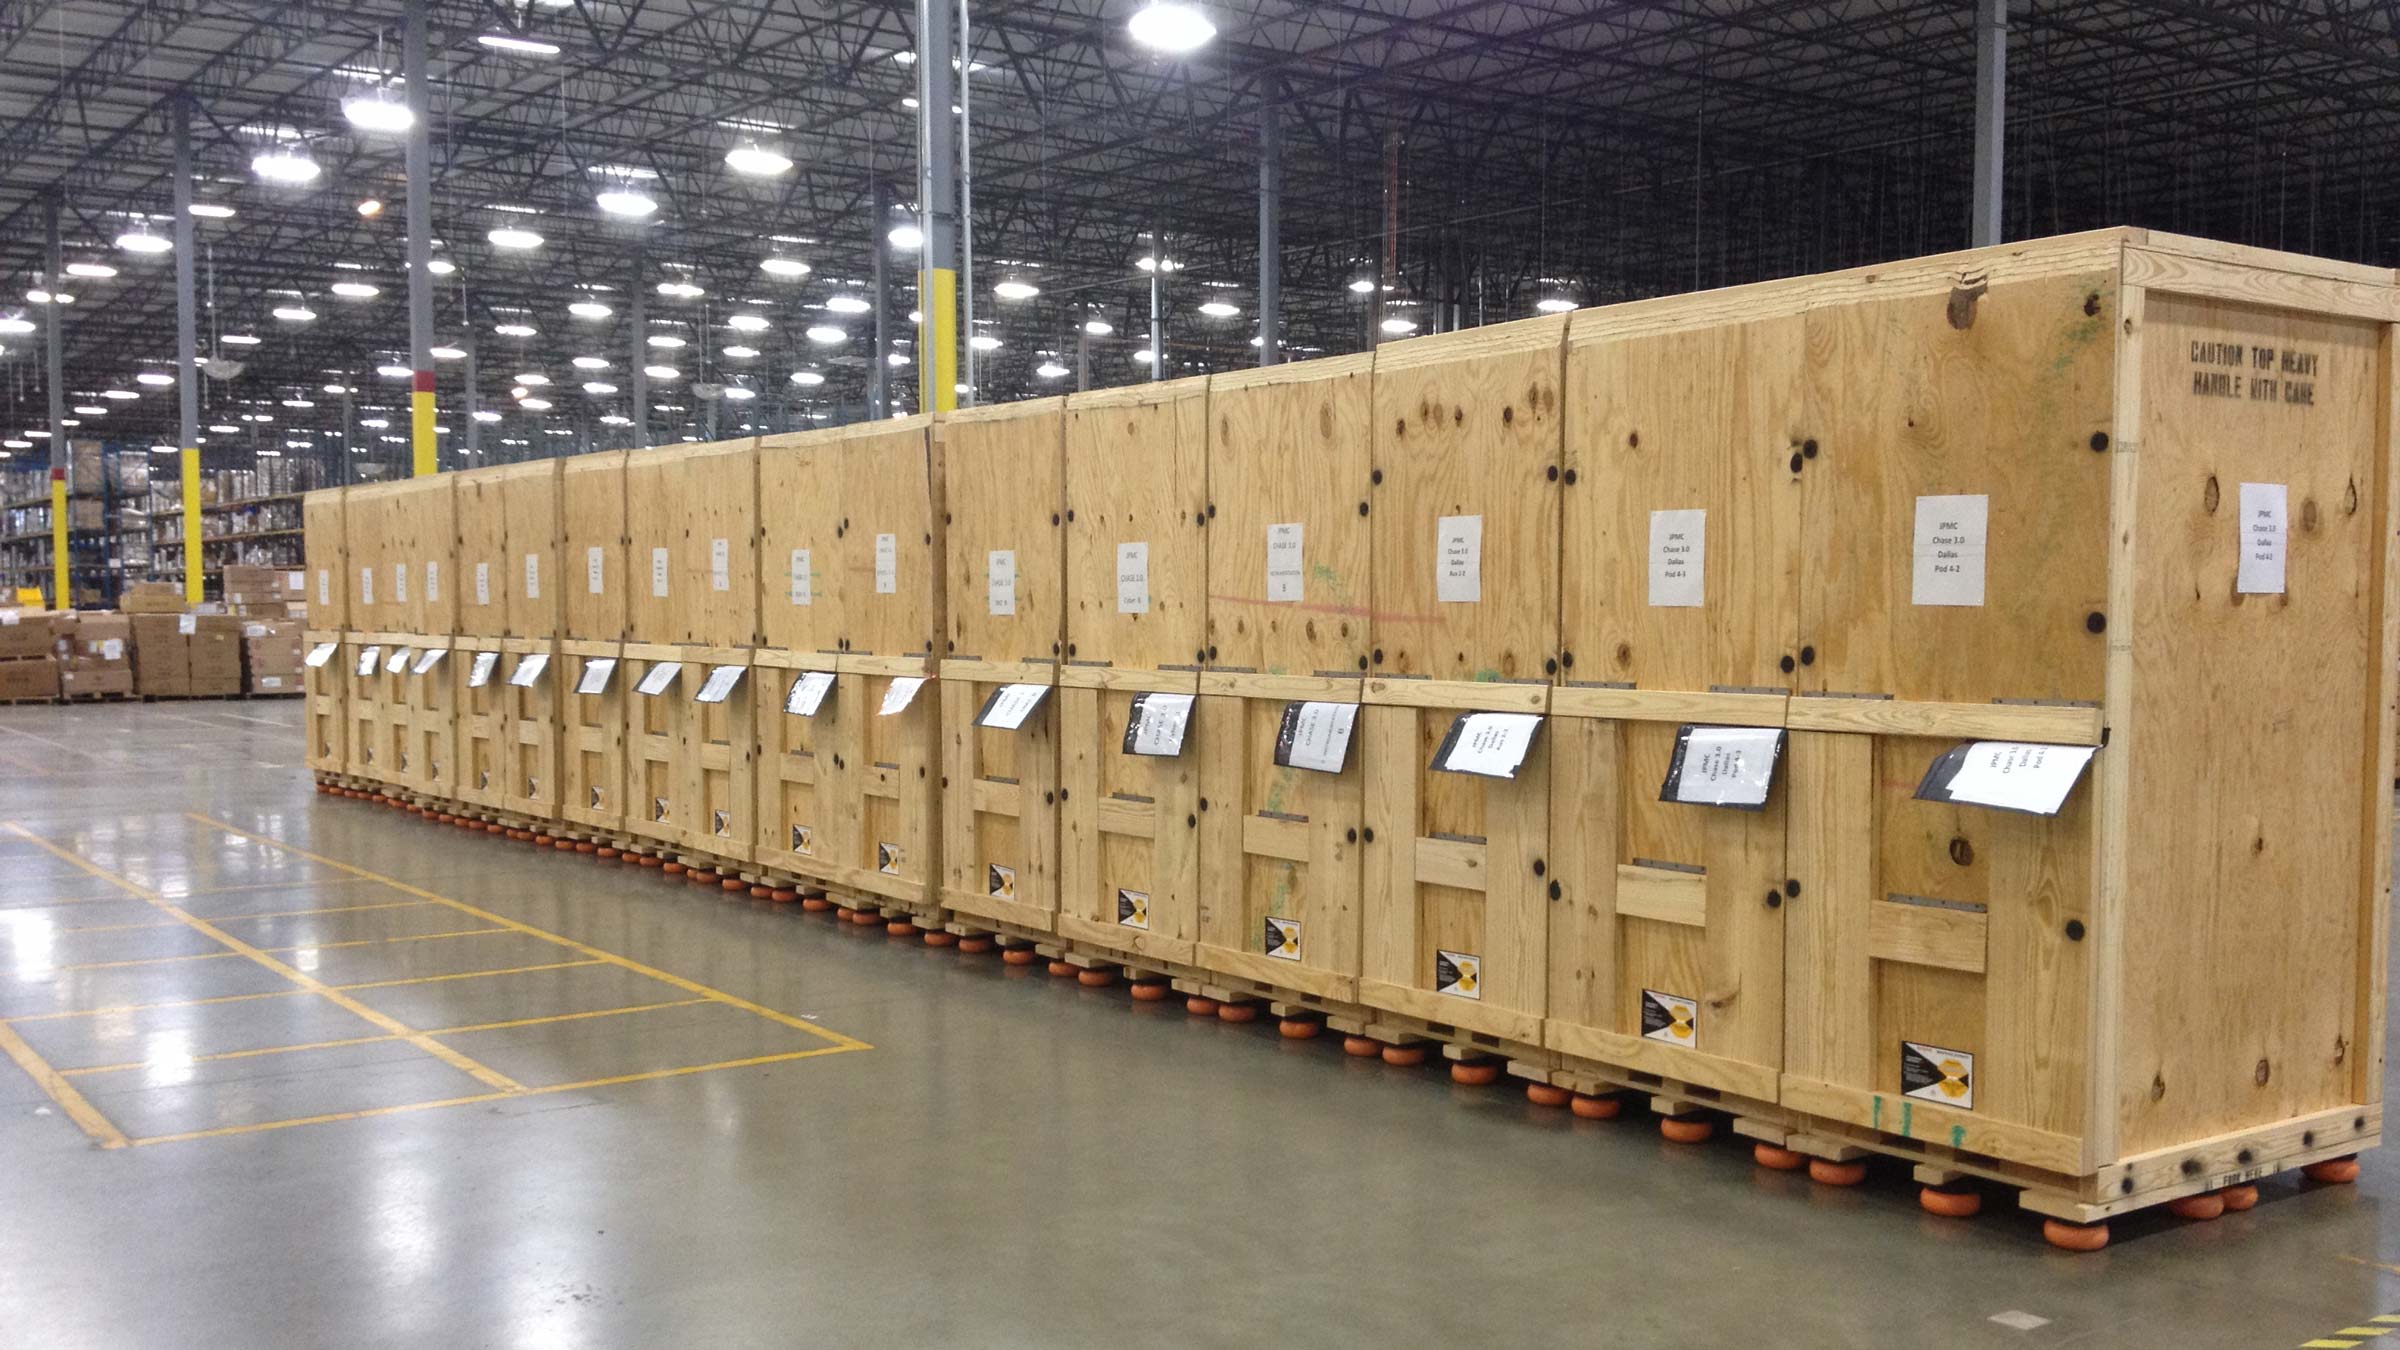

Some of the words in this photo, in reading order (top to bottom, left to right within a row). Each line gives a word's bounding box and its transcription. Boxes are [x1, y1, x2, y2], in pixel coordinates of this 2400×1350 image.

[2191, 340, 2243, 367] CAUTION
[2252, 346, 2274, 370] TOP
[2281, 350, 2319, 377] HEAVY
[2193, 371, 2241, 398] HANDLE
[2250, 378, 2277, 401] WITH
[1939, 522, 1958, 530] JPMC
[1932, 536, 1952, 544] Chase
[1954, 536, 1966, 544] 3.0
[1663, 545, 1680, 553] Chase
[1681, 545, 1690, 553] 3.0
[1937, 550, 1958, 558] Dallas
[1934, 565, 1948, 573] Pod
[1949, 565, 1961, 573] 4-2
[1664, 570, 1676, 578] Pod
[1702, 754, 1710, 773] JPMC
[1722, 753, 1731, 775] Dallas
[1710, 760, 1719, 781] Chase
